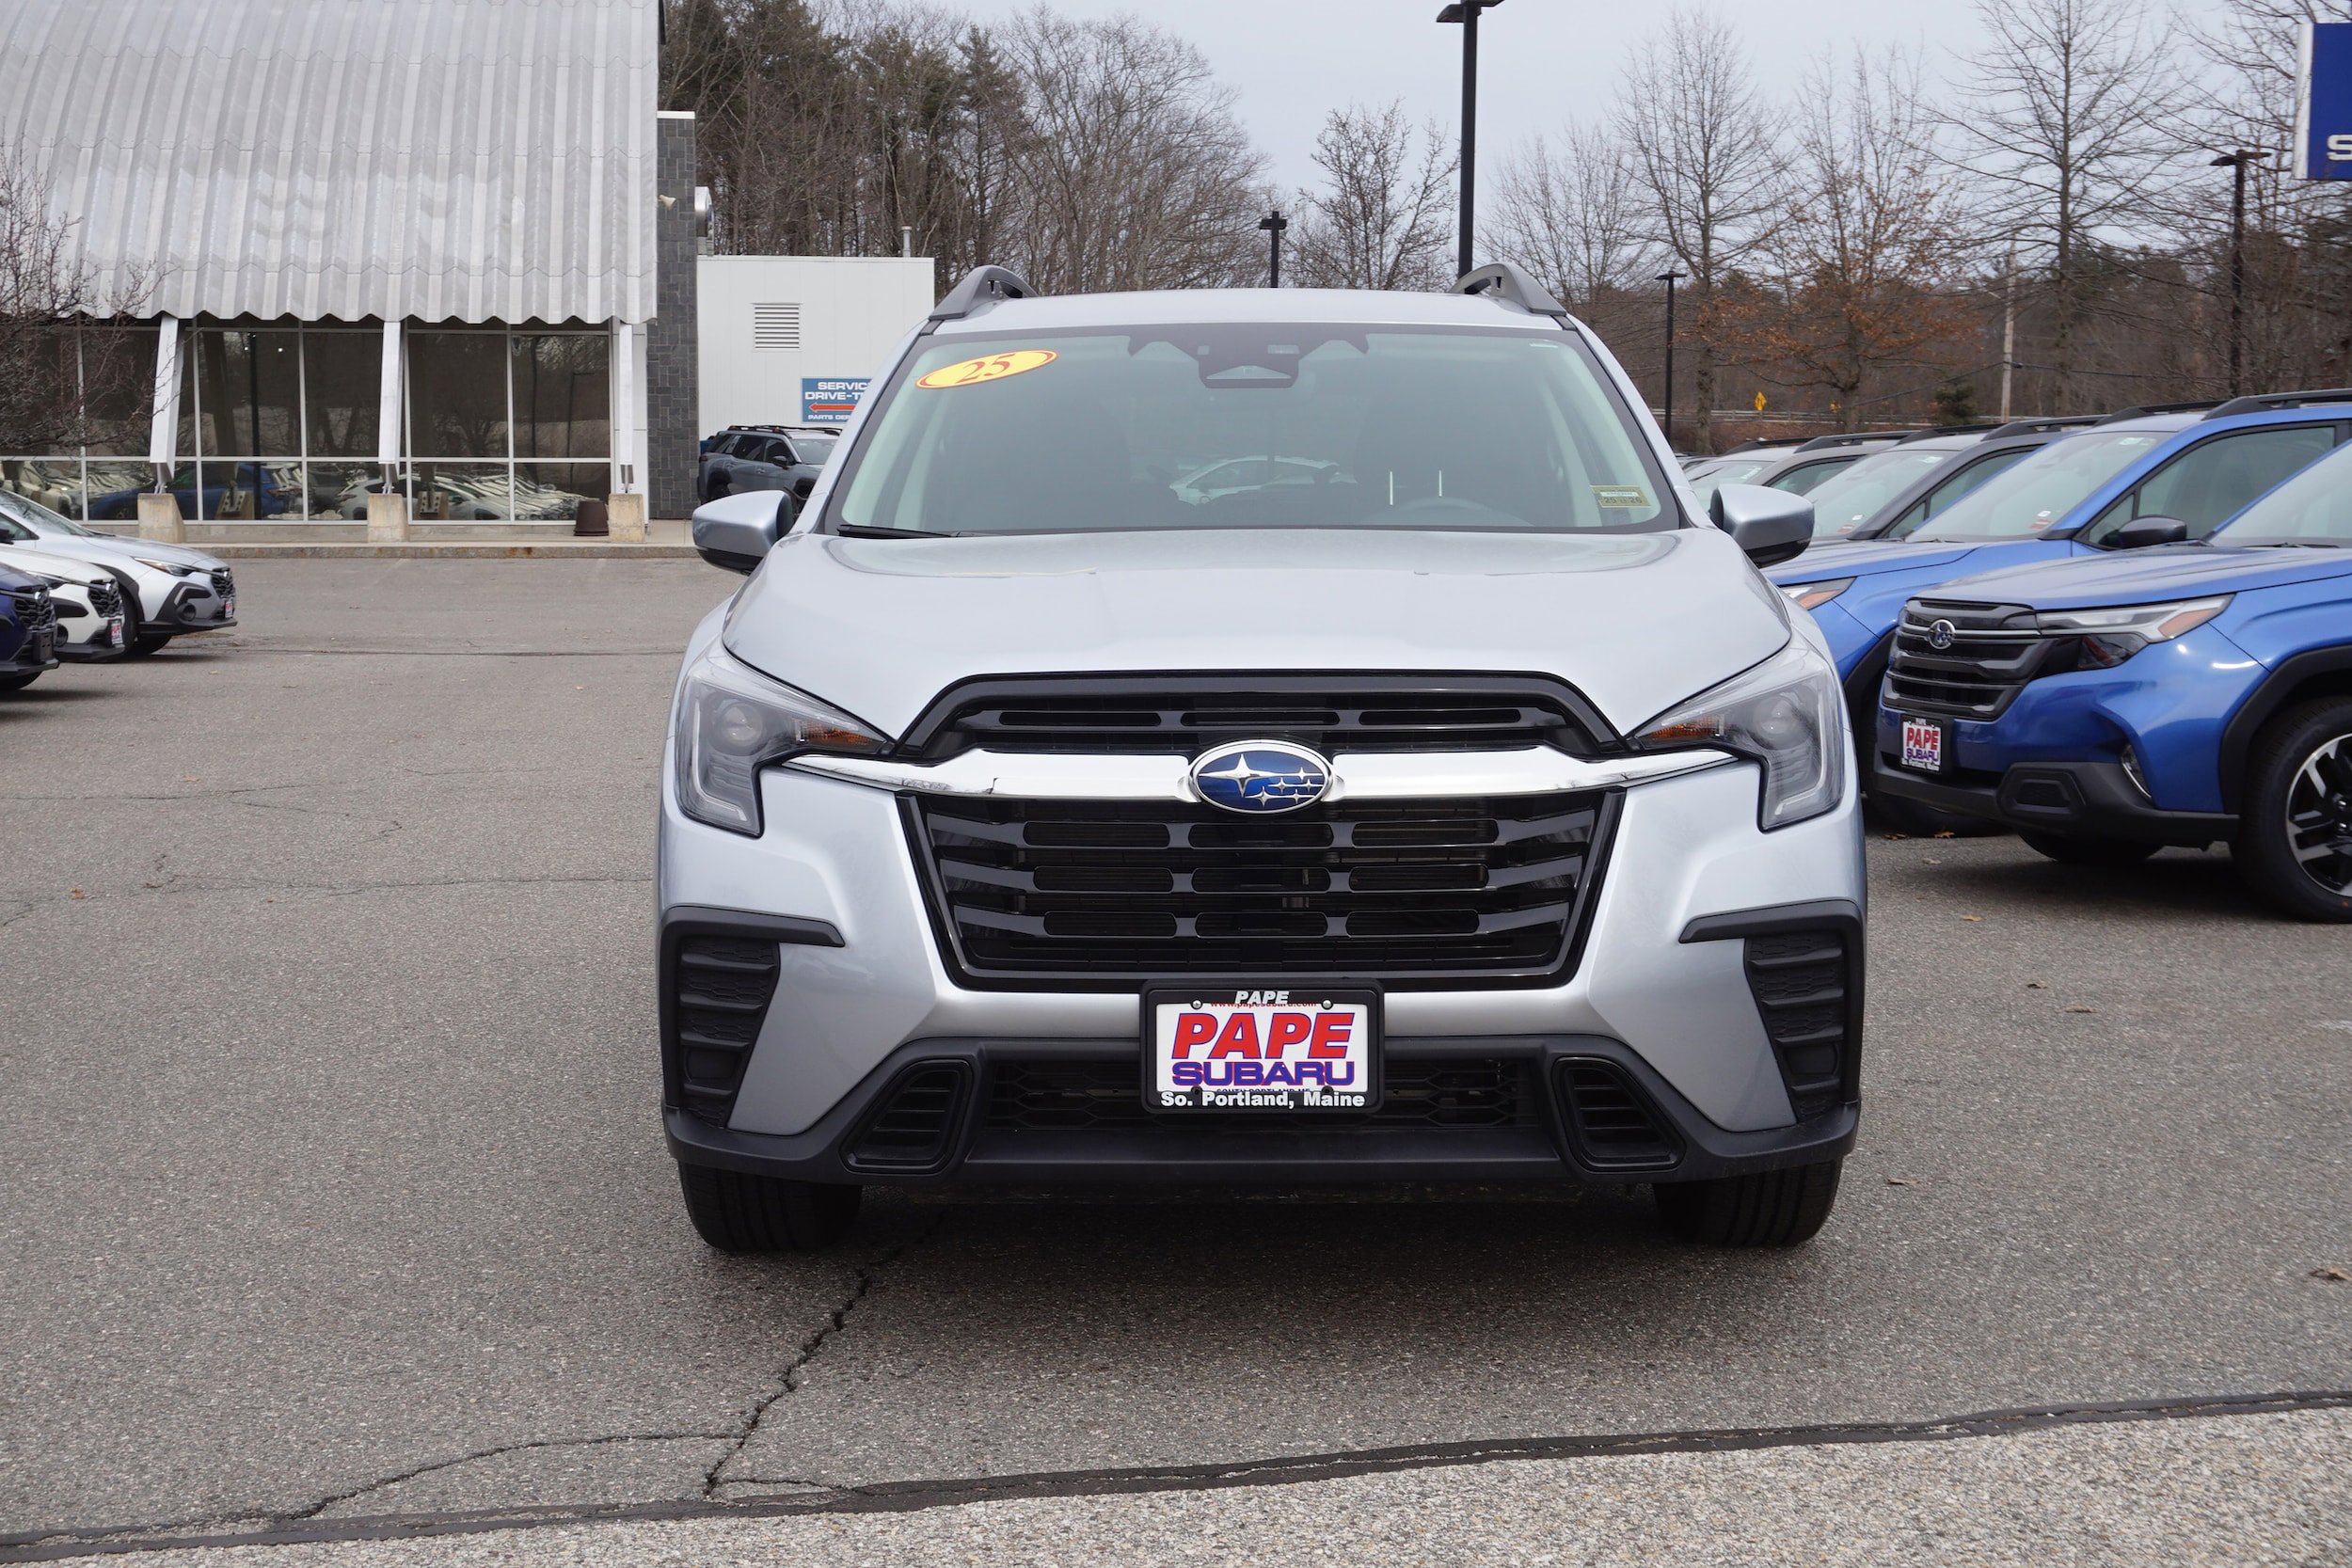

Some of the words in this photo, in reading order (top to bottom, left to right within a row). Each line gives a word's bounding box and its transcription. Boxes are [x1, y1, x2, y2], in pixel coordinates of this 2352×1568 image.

[955, 353, 1017, 384] 25
[818, 382, 867, 390] SERVIC
[1906, 728, 1939, 750] PAPE
[1906, 748, 1939, 762] SUBARU
[1234, 990, 1290, 1005] PAPE
[1171, 1012, 1355, 1059] PAPE
[1172, 1061, 1355, 1086] SUBARU
[1160, 1091, 1193, 1107] So.
[1202, 1091, 1295, 1109] Portland,
[1303, 1091, 1365, 1107] Maine
